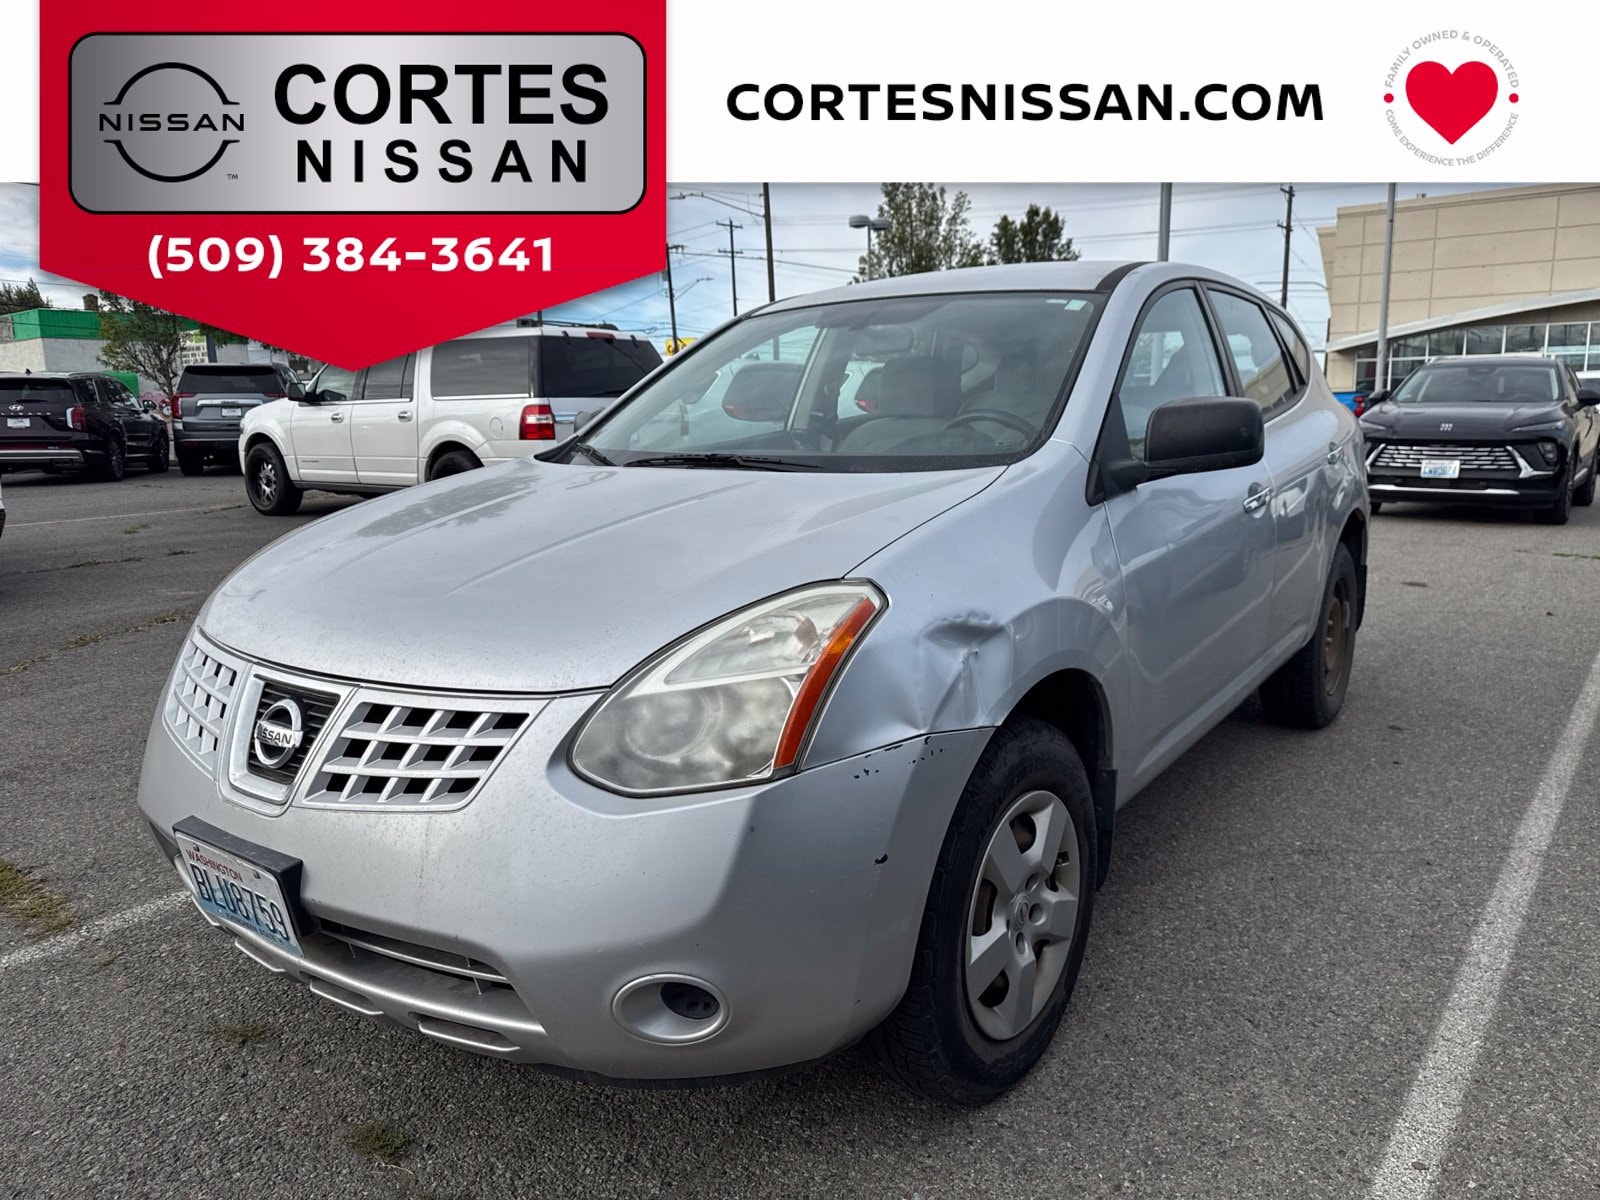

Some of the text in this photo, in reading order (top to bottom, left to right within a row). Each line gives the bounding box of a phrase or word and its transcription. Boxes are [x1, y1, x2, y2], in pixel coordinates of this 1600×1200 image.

[257, 723, 293, 745] SSAN
[186, 849, 243, 882] WASHINGTON
[189, 863, 289, 941] BLU8759
